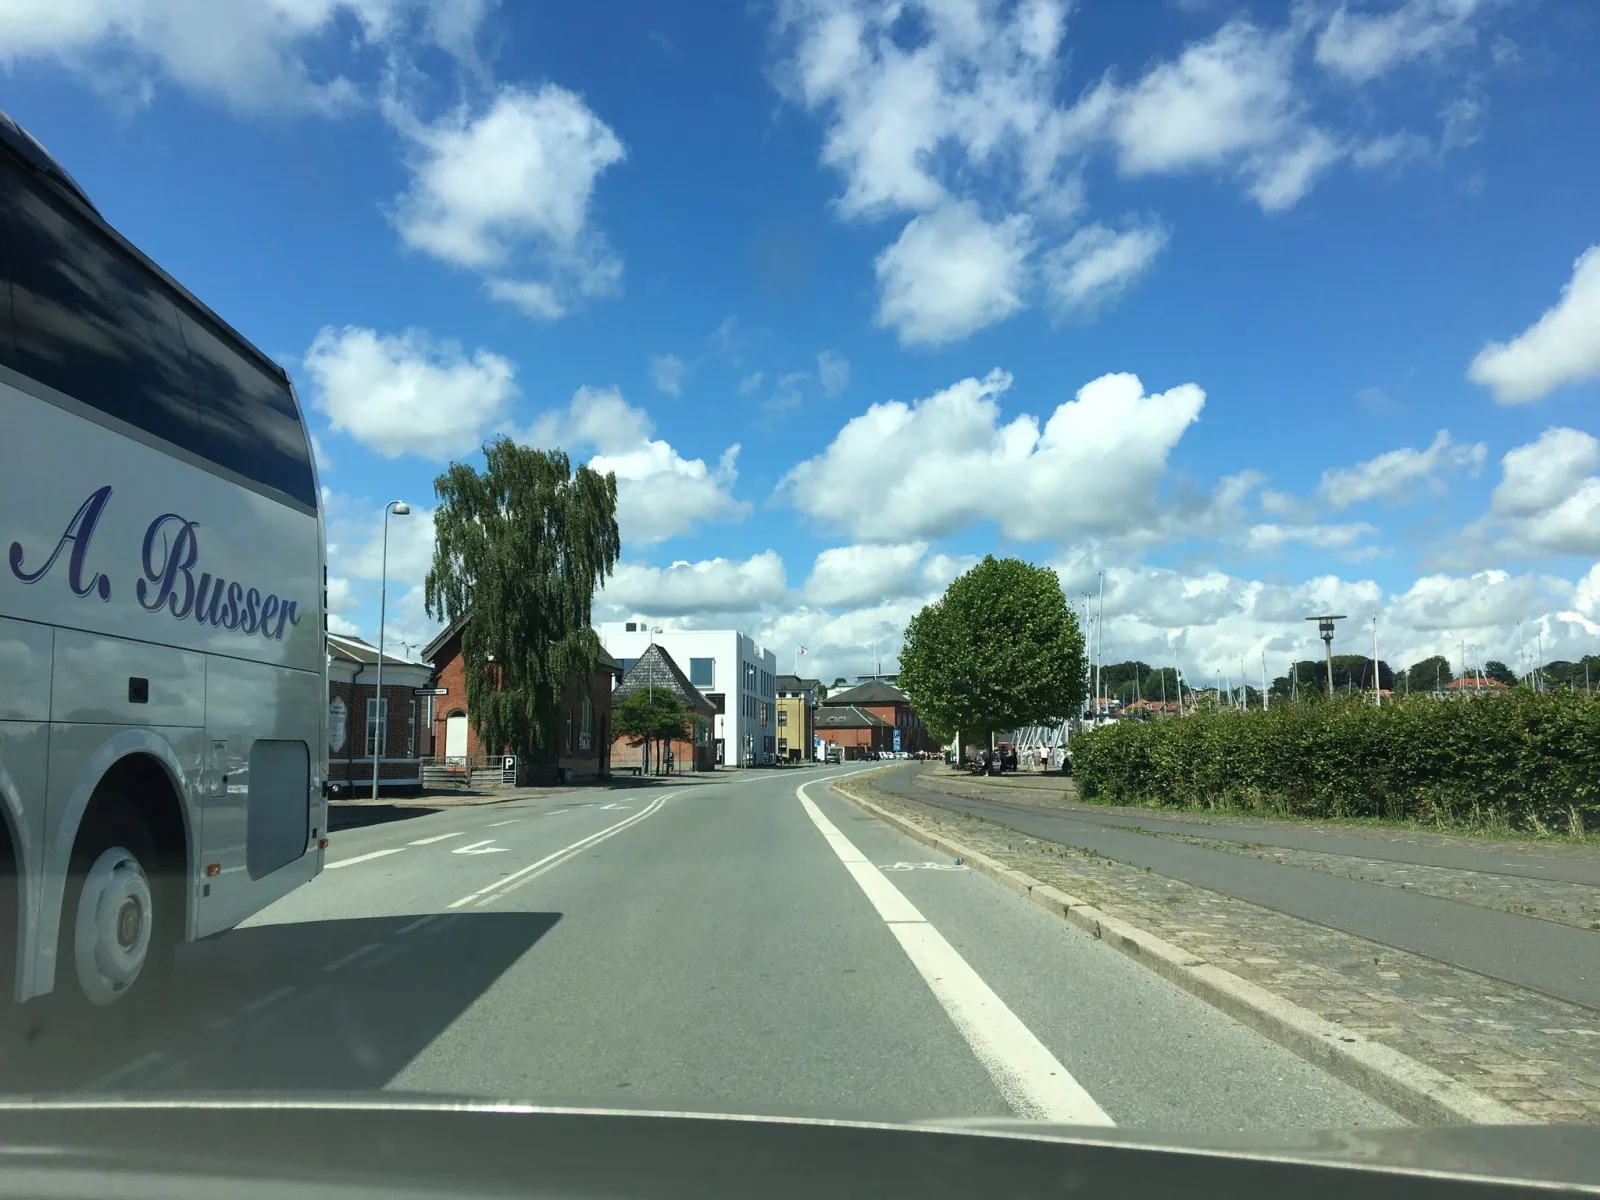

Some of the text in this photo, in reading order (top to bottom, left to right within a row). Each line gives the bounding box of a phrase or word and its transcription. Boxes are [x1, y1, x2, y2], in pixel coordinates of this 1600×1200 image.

[9, 485, 300, 641] A. Busser
[505, 757, 514, 770] P
